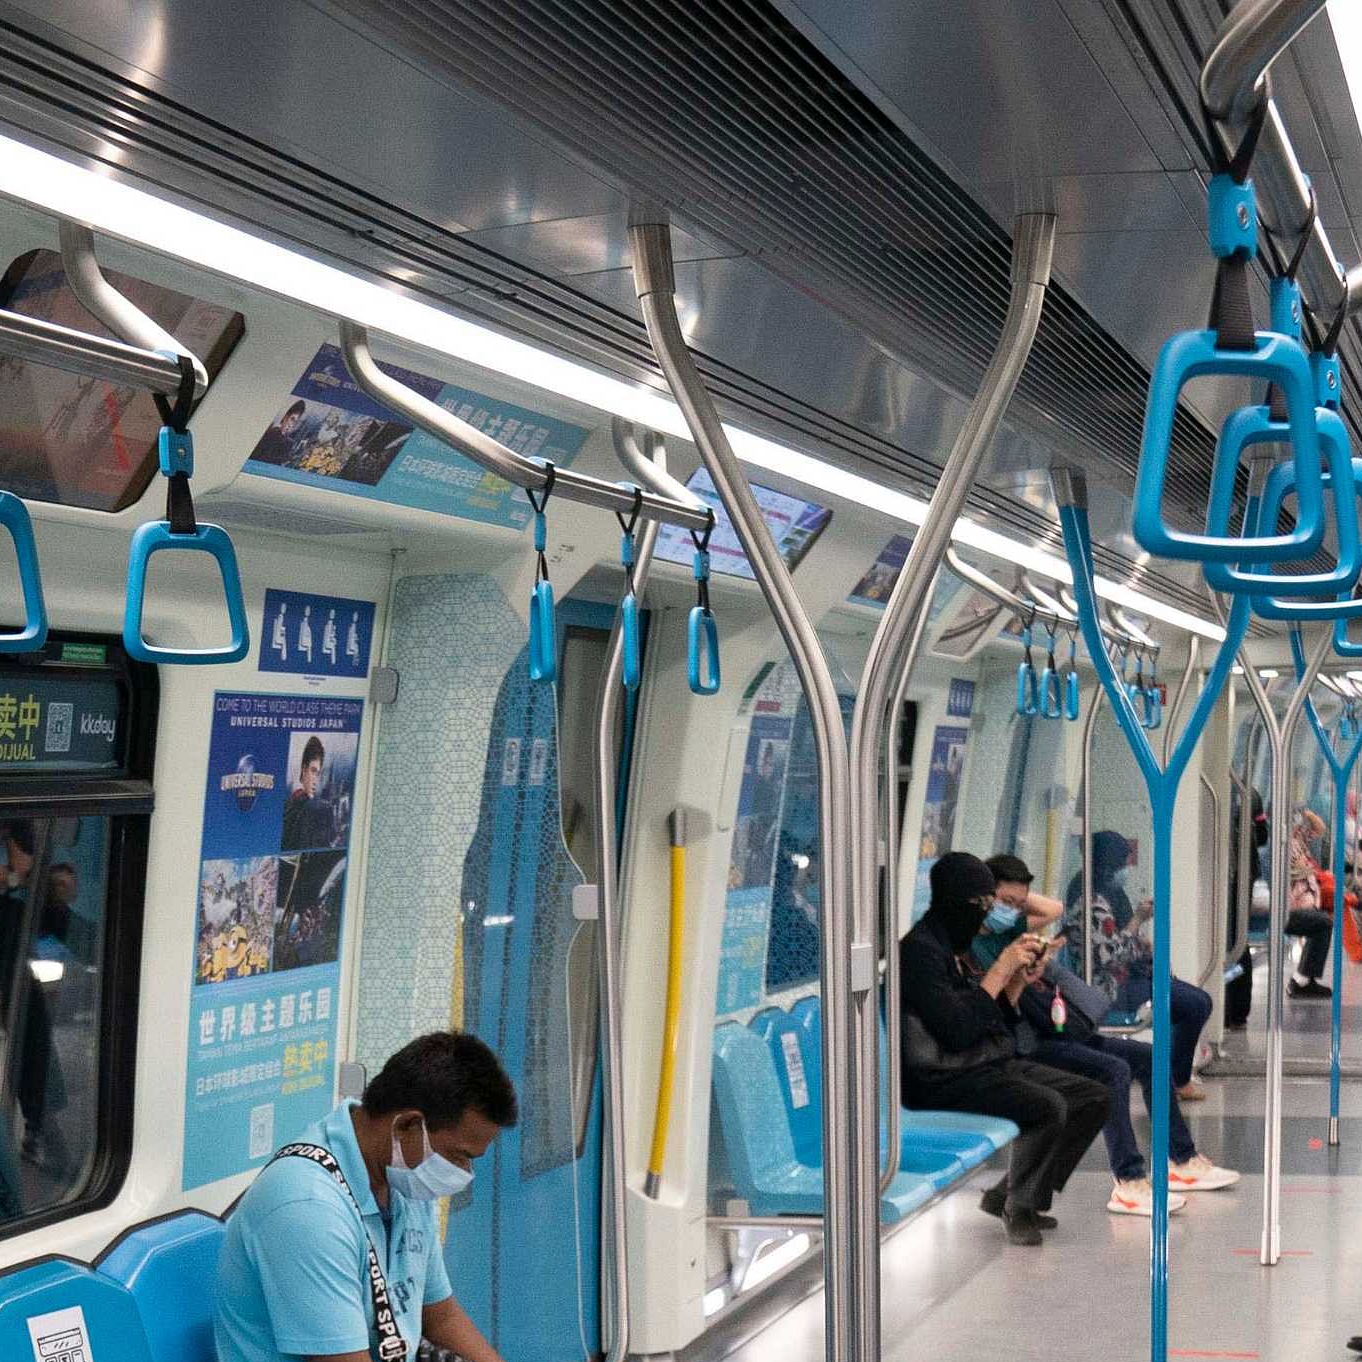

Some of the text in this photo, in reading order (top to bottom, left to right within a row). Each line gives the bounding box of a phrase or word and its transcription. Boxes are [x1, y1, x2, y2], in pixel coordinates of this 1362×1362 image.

[80, 713, 117, 743] kkday
[230, 716, 278, 728] UNIVERSAL
[282, 717, 317, 729] STUDIOS
